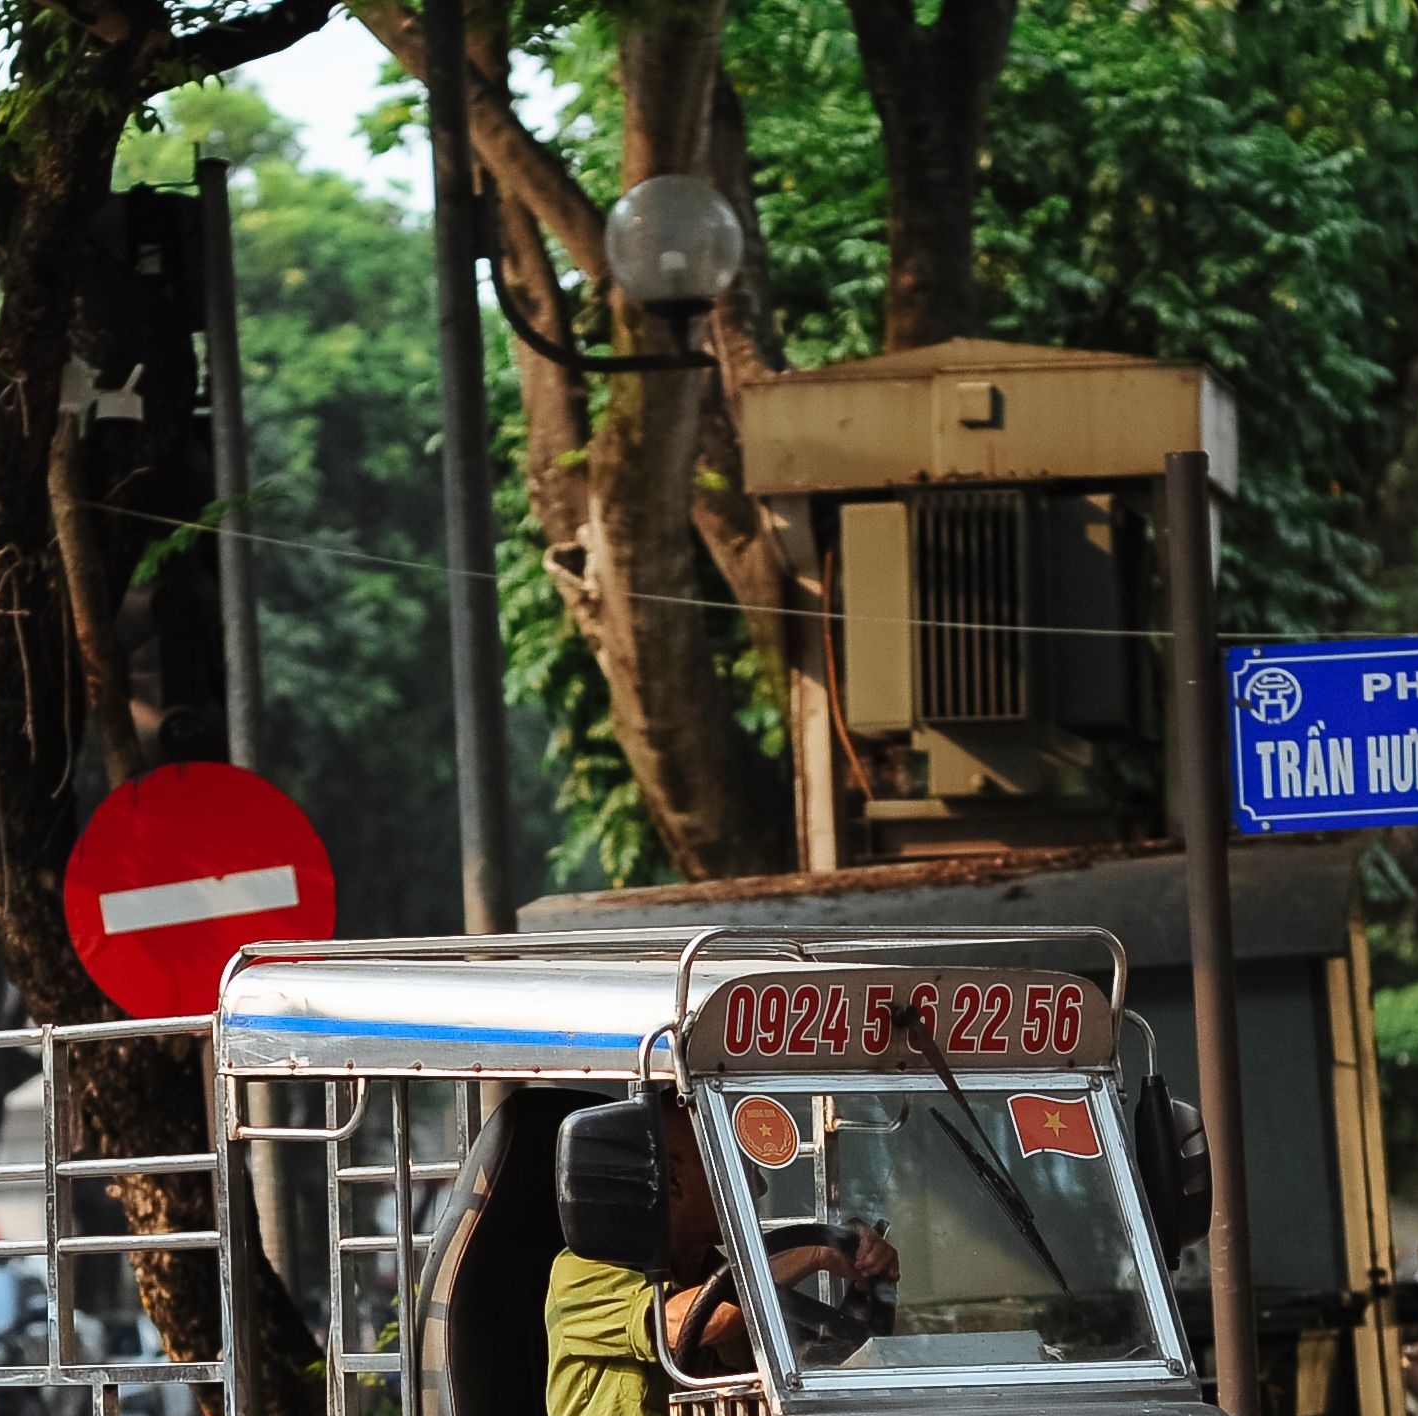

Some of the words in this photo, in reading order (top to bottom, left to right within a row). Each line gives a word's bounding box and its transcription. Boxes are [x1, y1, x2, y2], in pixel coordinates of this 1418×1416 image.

[1255, 719, 1355, 800] TRẦN
[723, 982, 851, 1057] 0924
[946, 982, 1014, 1055] 22
[1021, 982, 1084, 1056] 56
